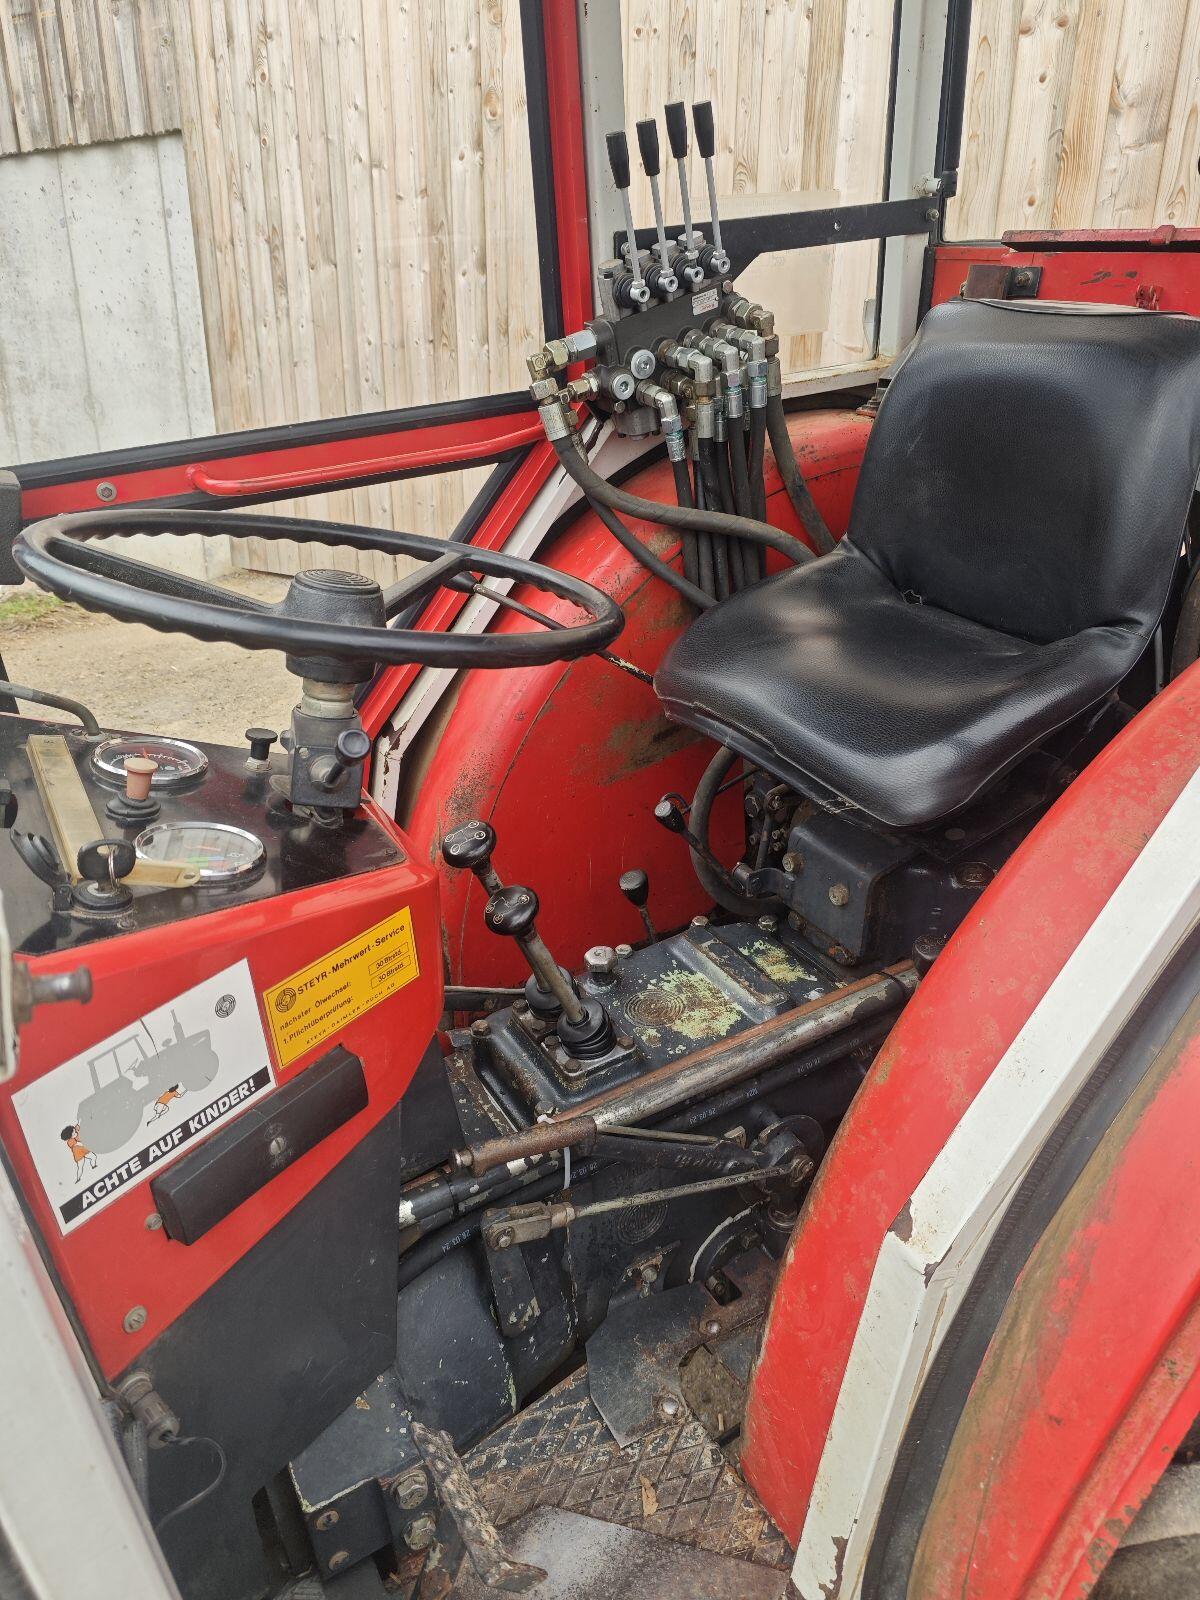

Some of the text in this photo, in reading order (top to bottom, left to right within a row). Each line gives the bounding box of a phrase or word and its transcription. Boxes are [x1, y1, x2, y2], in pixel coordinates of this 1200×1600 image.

[280, 1007, 311, 1031] nächster
[314, 981, 352, 1008] Ölwechsel:
[82, 1078, 256, 1210] ACHTE AUF KINDER!
